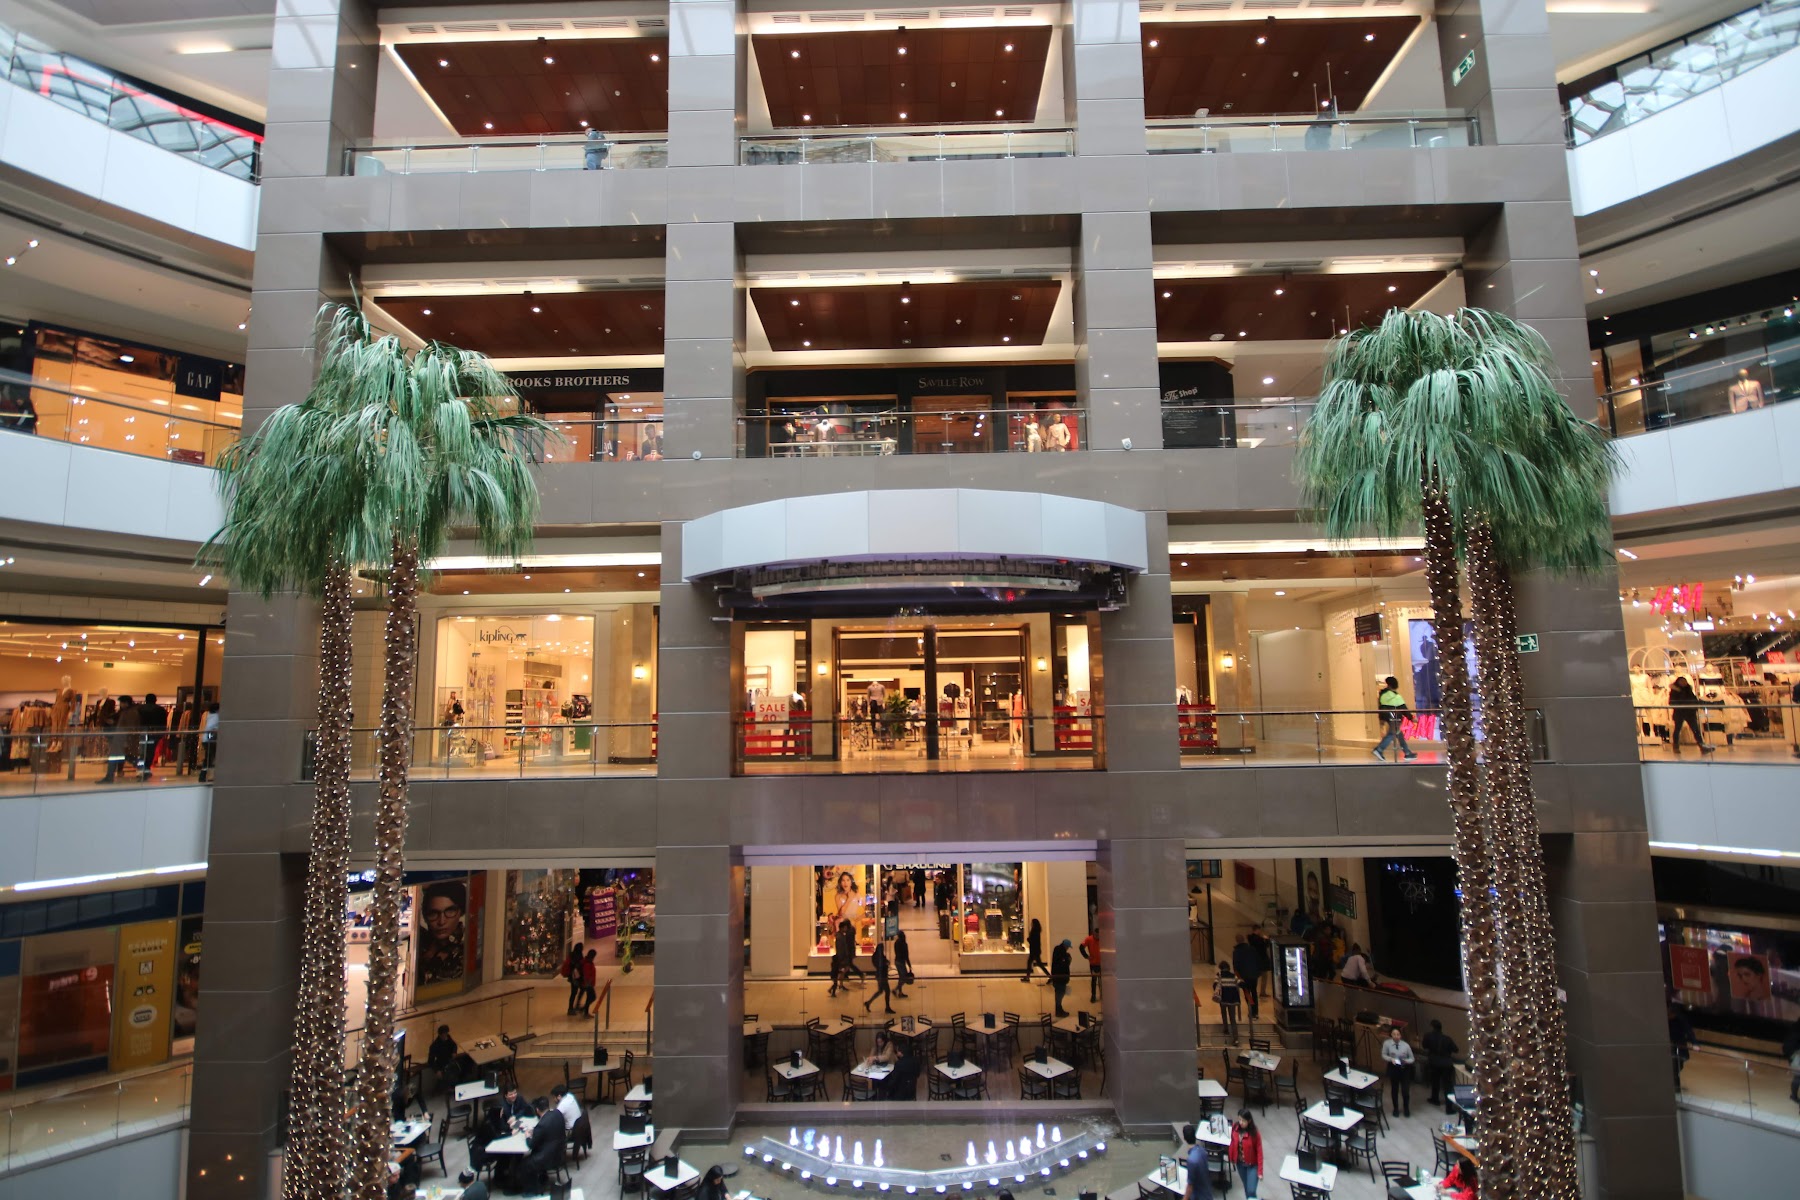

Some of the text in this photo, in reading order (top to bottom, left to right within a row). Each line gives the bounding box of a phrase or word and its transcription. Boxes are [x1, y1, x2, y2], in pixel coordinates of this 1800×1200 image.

[187, 371, 212, 389] GAP
[505, 375, 630, 388] ROOKS BROTHERS
[959, 376, 985, 388] ROW
[1164, 388, 1198, 402] The Shop
[759, 703, 786, 713] SALE
